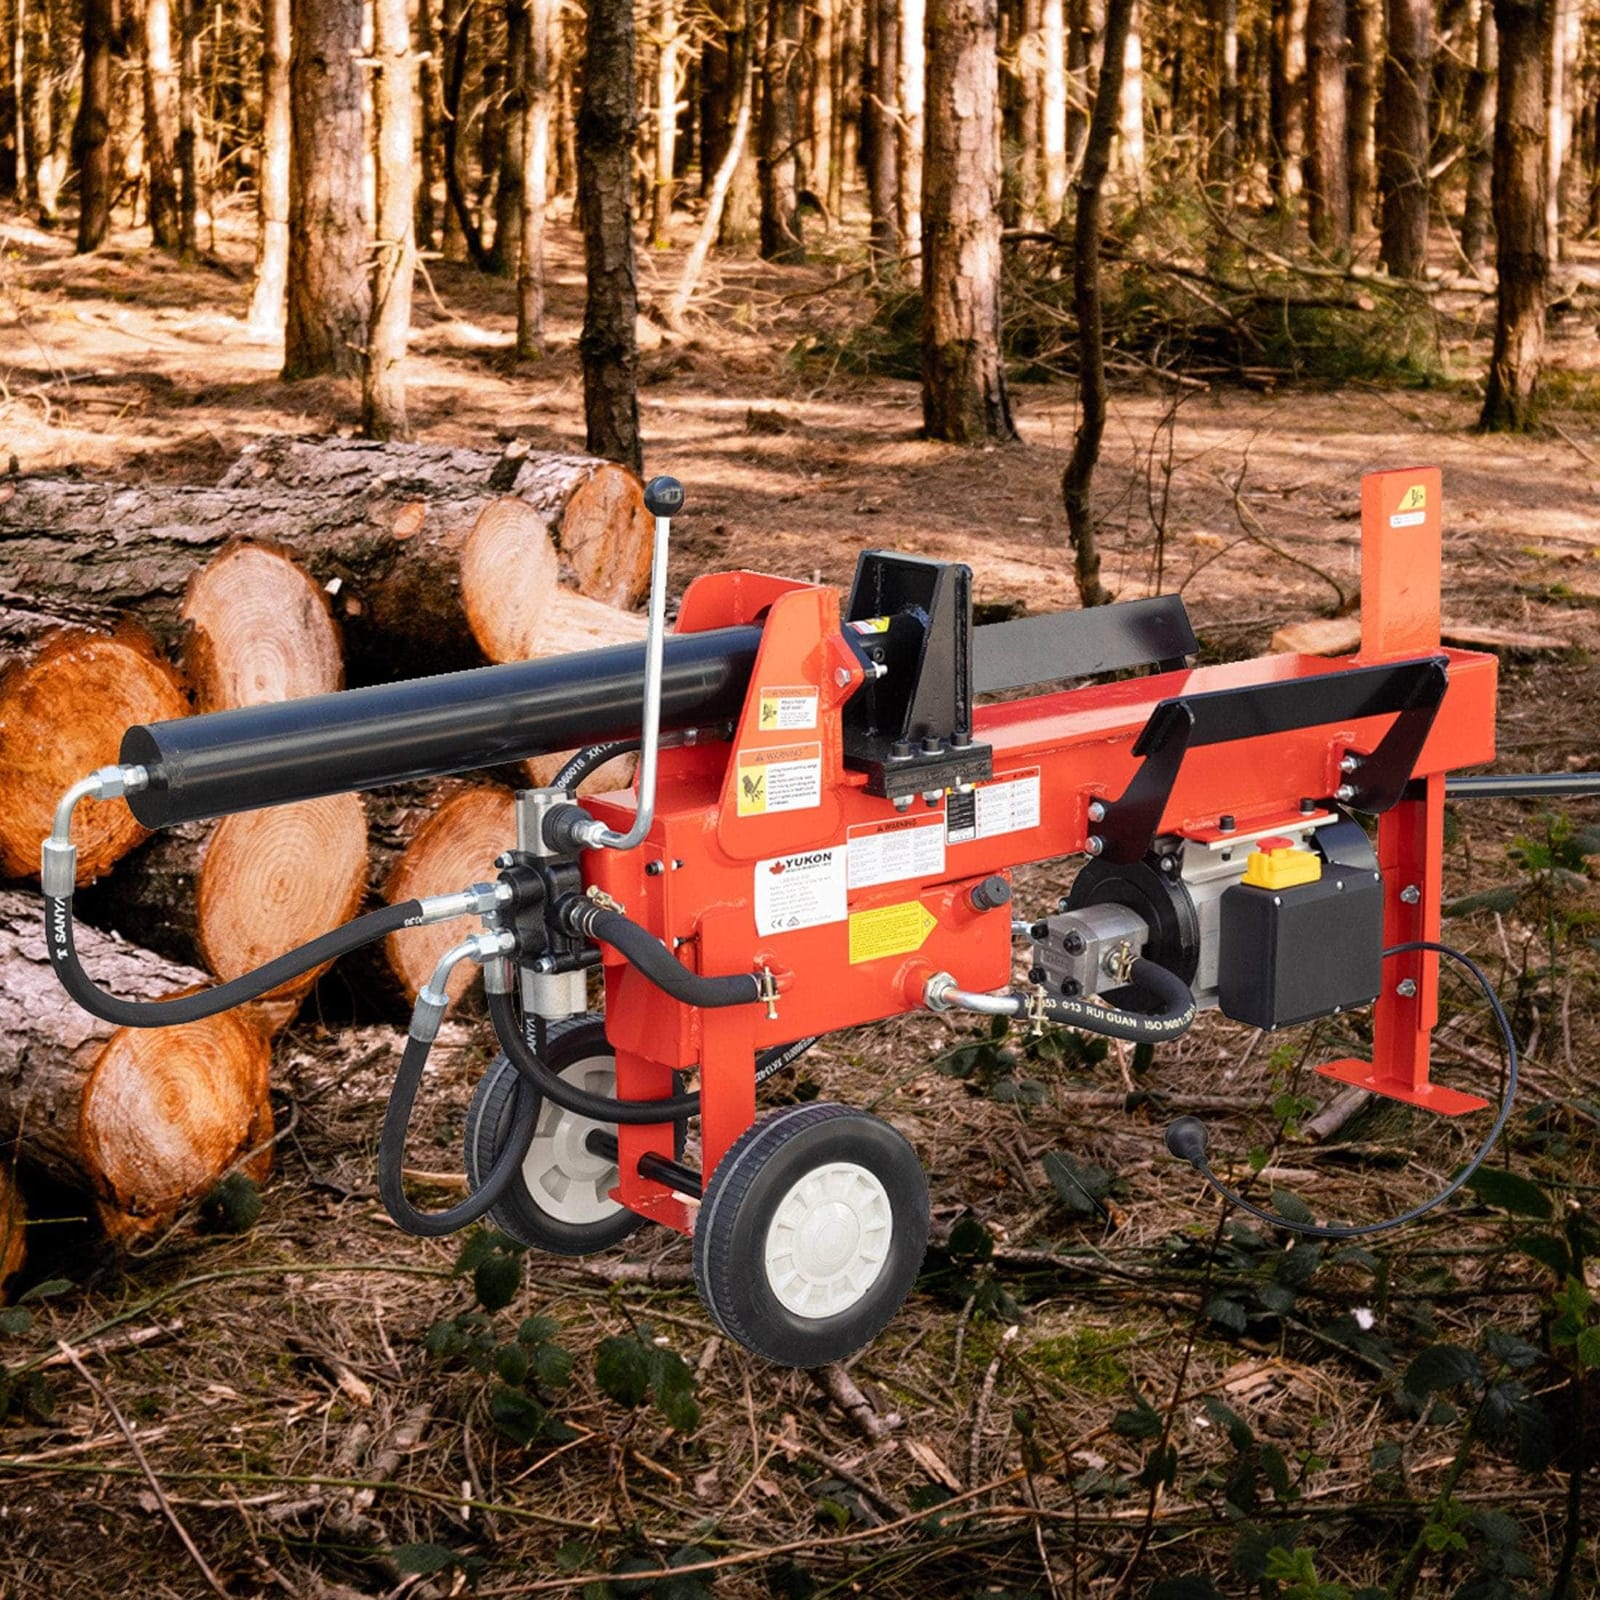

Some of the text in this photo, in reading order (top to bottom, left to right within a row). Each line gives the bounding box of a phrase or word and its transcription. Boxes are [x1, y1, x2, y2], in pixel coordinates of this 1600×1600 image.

[785, 852, 832, 868] YUKON
[1086, 1006, 1104, 1019] RUI
[1106, 1012, 1137, 1028] GUAN
[1144, 1020, 1163, 1031] ISO
